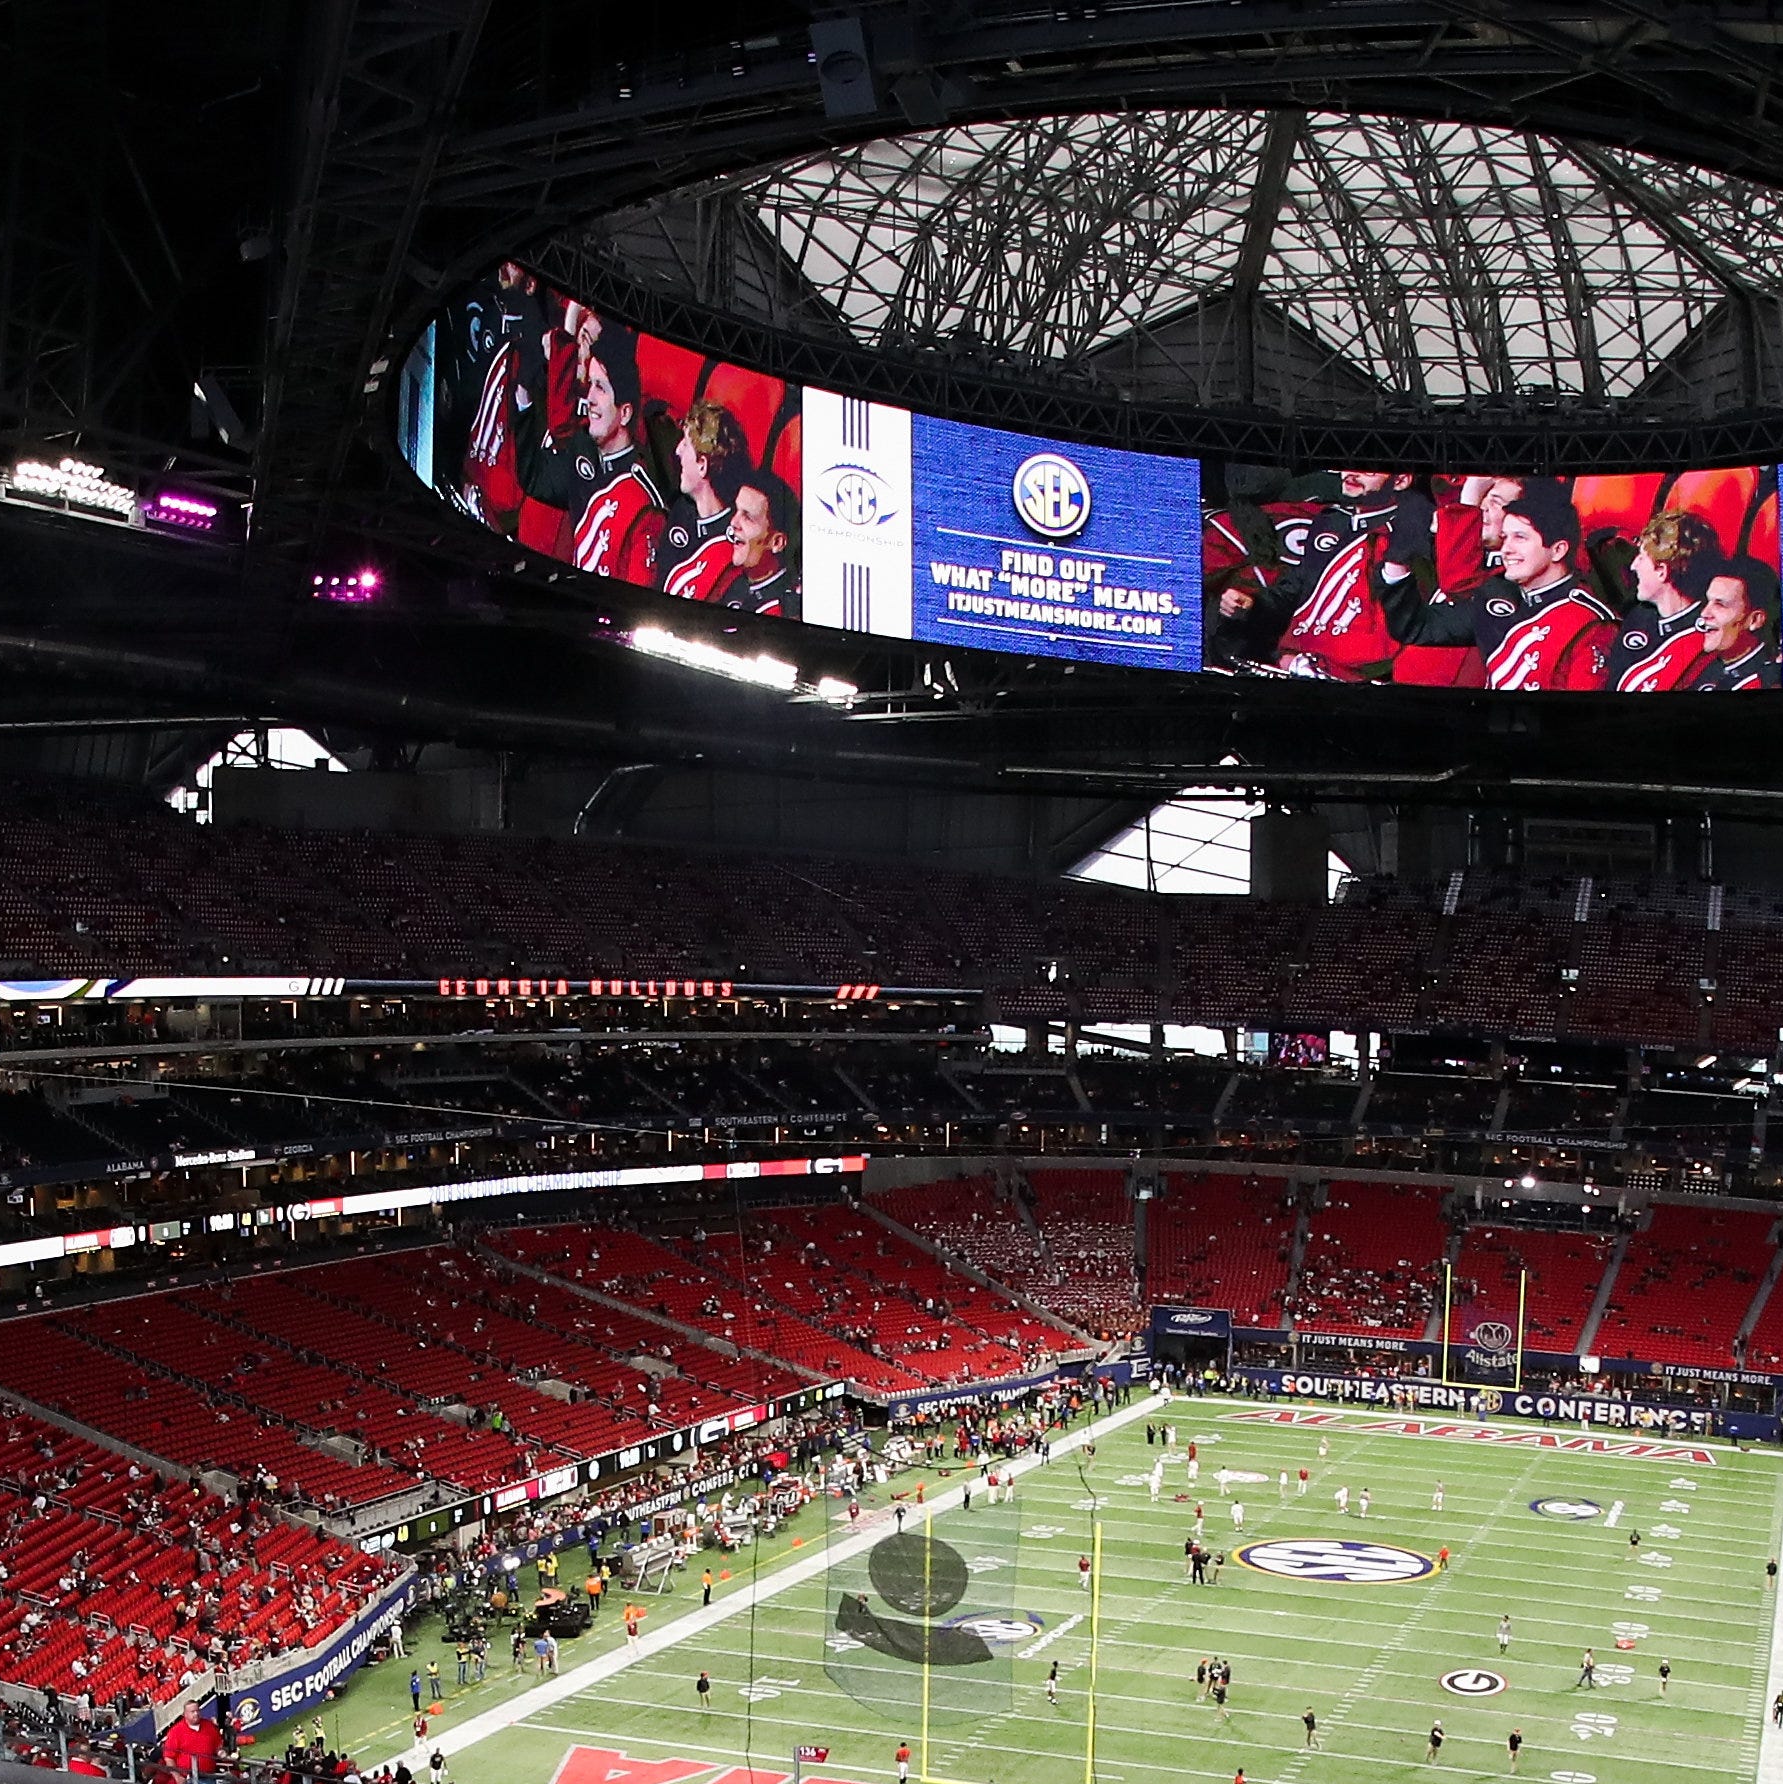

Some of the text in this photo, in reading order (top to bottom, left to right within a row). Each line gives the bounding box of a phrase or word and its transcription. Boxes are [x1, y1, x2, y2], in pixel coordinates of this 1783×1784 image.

[838, 475, 876, 524] SEC
[1022, 464, 1084, 529] SEC
[808, 524, 905, 549] CHAMPIONSHIP
[1001, 550, 1106, 584] FIND OUT
[930, 562, 993, 591] WHAT
[1093, 585, 1182, 616] MEANS.
[948, 592, 1163, 636] ITJUSTMEANSMORE.COM
[439, 978, 733, 997] GEORGIA BULLDOGS
[714, 1112, 848, 1128] SOUTHEASTERN CONFERENCE
[394, 1127, 494, 1144] SEC FOOTBALL CHAMPIONSHIP
[1505, 1133, 1554, 1145] FOOTBALL
[1556, 1137, 1628, 1150] CHAMPIONSHIP
[174, 1148, 256, 1168] Mercedes-Benz Stadium
[283, 1143, 314, 1155] GEORGIA
[106, 1159, 145, 1173] ALABAMA
[1301, 1333, 1409, 1352] IT JUST MEANS MORE.
[1665, 1364, 1774, 1386] IT JUST MEANS MORE.
[1280, 1373, 1467, 1409] SOUTHEASTERN
[1215, 1408, 1718, 1466] ALABAMA
[1623, 1584, 1663, 1603] 50
[270, 1597, 406, 1713] SEC FOOTBALL CHAMPIONSHIP
[1446, 1671, 1503, 1695] G
[1569, 1711, 1619, 1738] 20
[799, 1746, 817, 1757] 136
